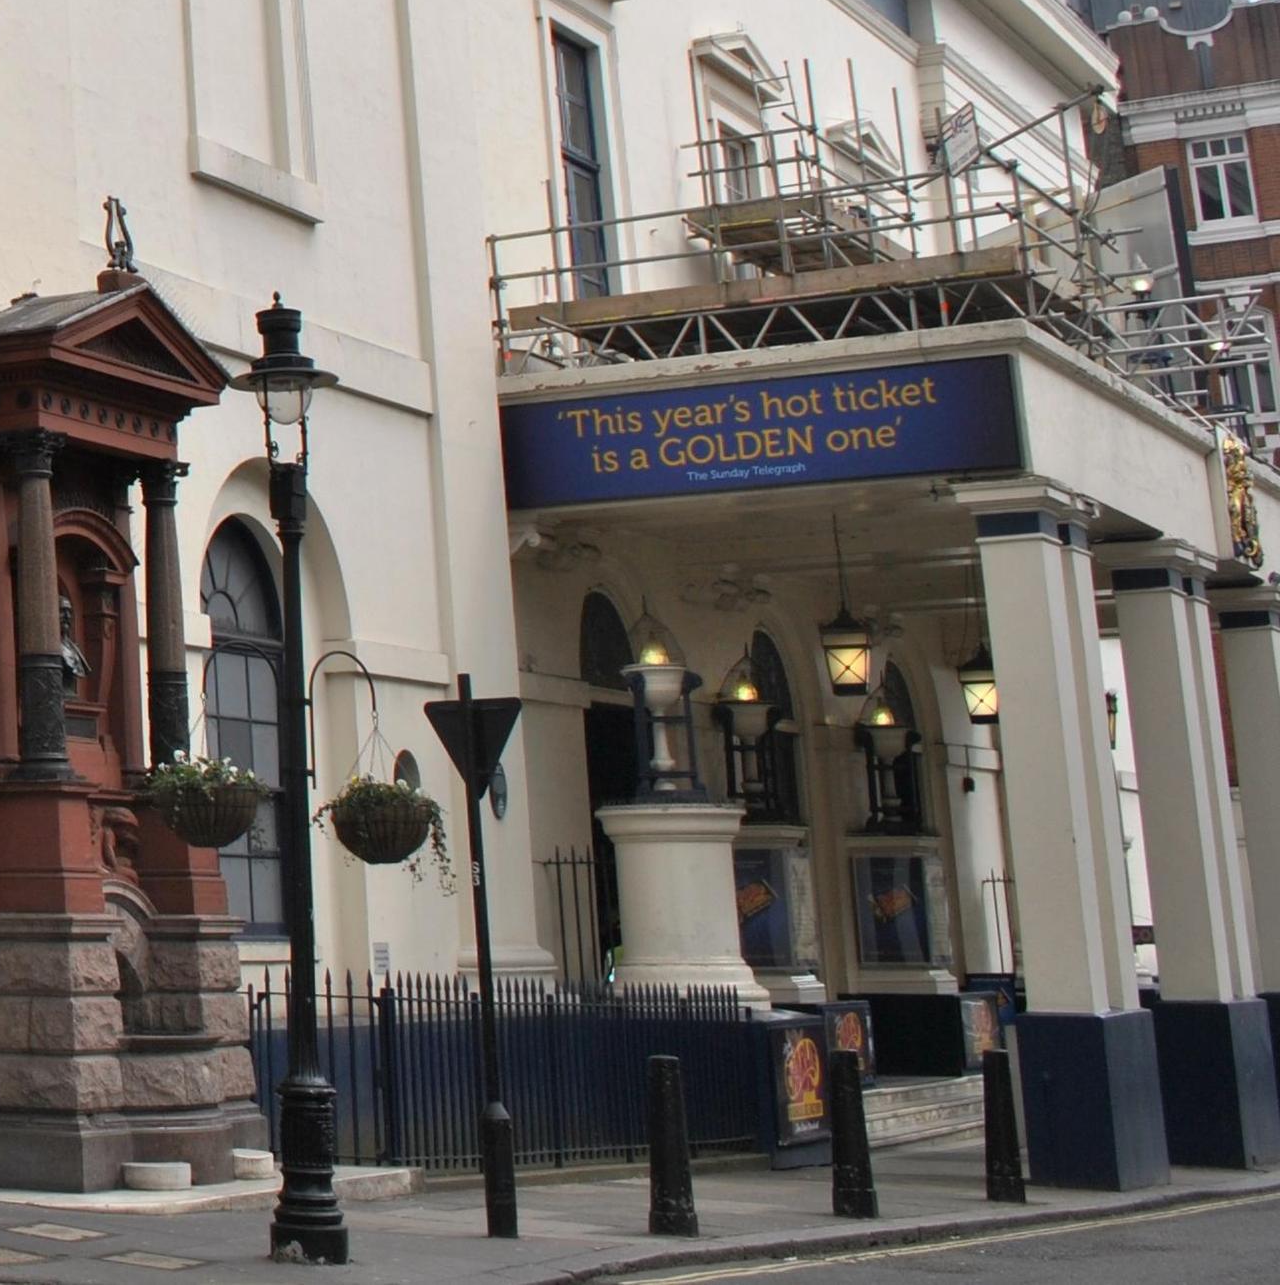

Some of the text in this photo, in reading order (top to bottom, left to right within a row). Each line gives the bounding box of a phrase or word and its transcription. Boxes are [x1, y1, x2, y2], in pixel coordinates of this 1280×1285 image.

[652, 394, 750, 438] year's
[760, 389, 822, 420] hot
[833, 376, 937, 411] ticket
[592, 416, 902, 474] is a GOLDEN one'
[686, 462, 807, 482] The Sunday Telegraph
